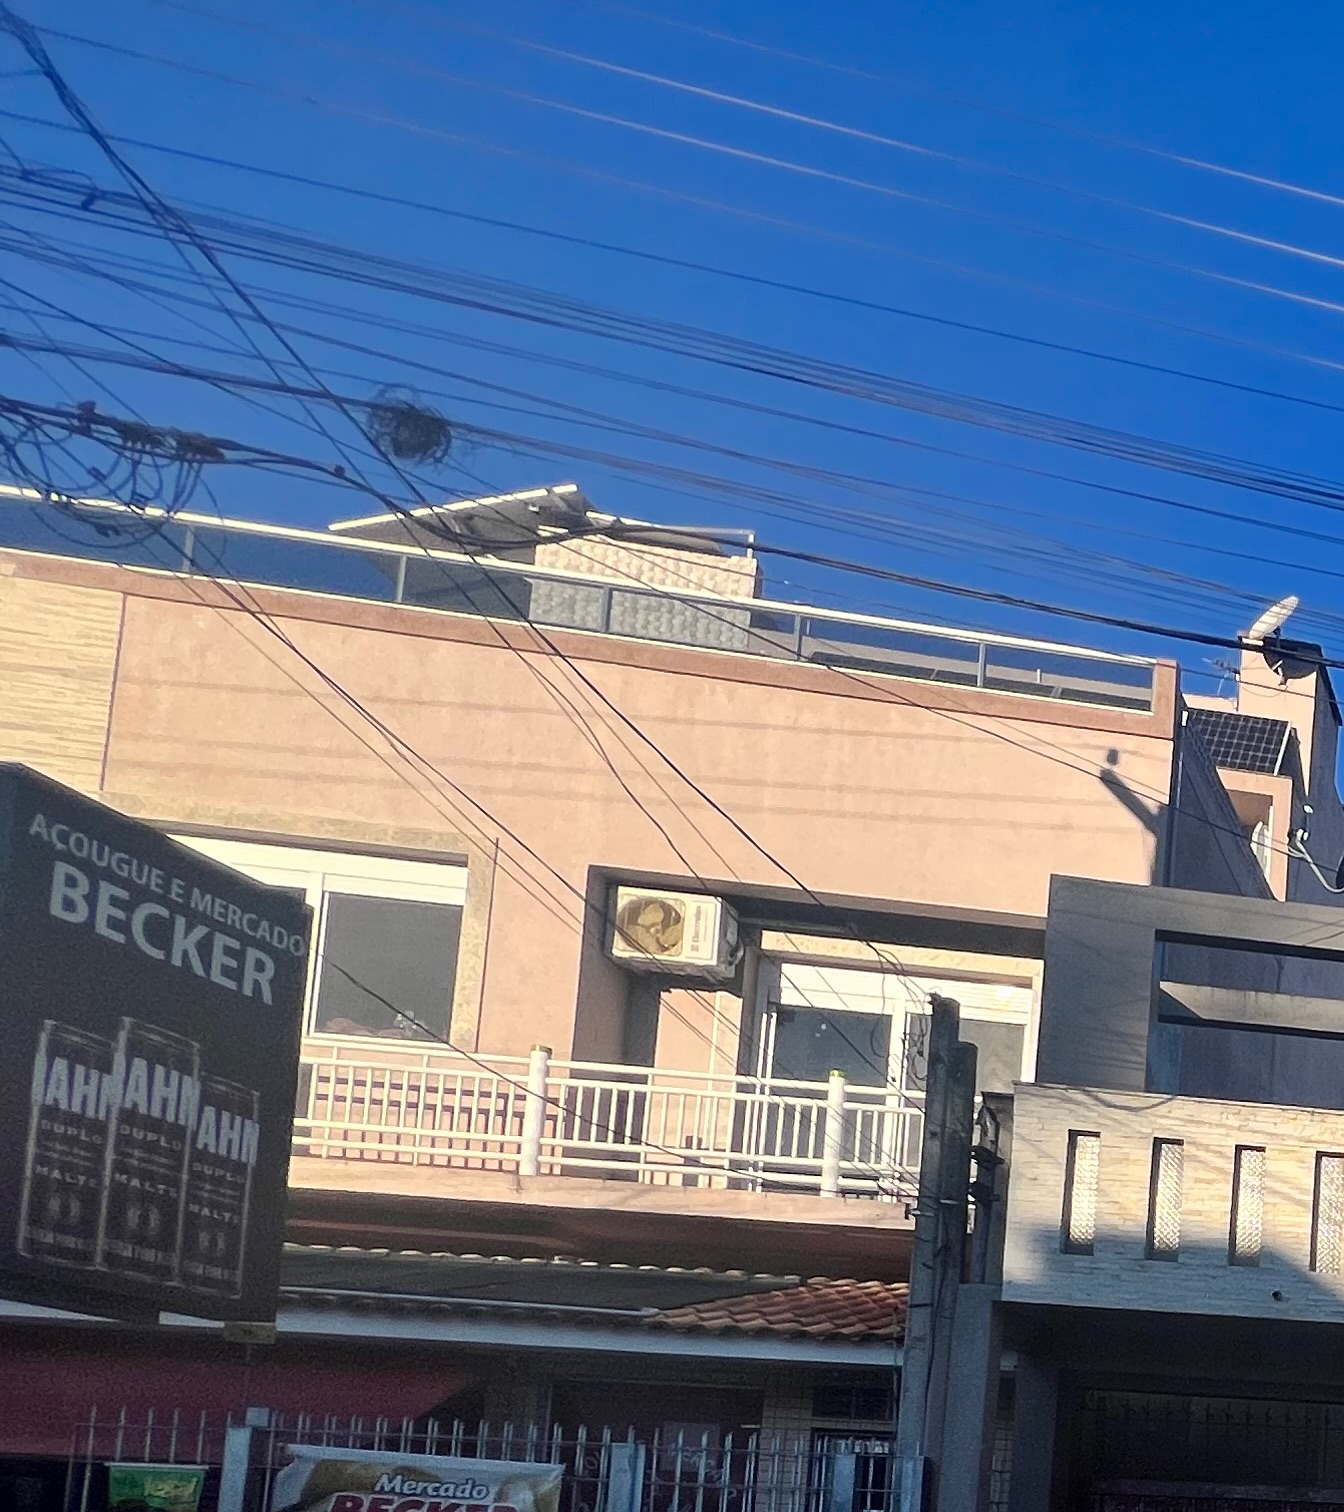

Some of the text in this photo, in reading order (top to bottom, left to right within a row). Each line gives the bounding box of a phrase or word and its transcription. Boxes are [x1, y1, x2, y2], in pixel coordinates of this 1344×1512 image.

[29, 813, 306, 957] AÇOUGUE E MERCADO
[50, 860, 275, 1006] BECKER
[374, 1473, 490, 1500] Mercado
